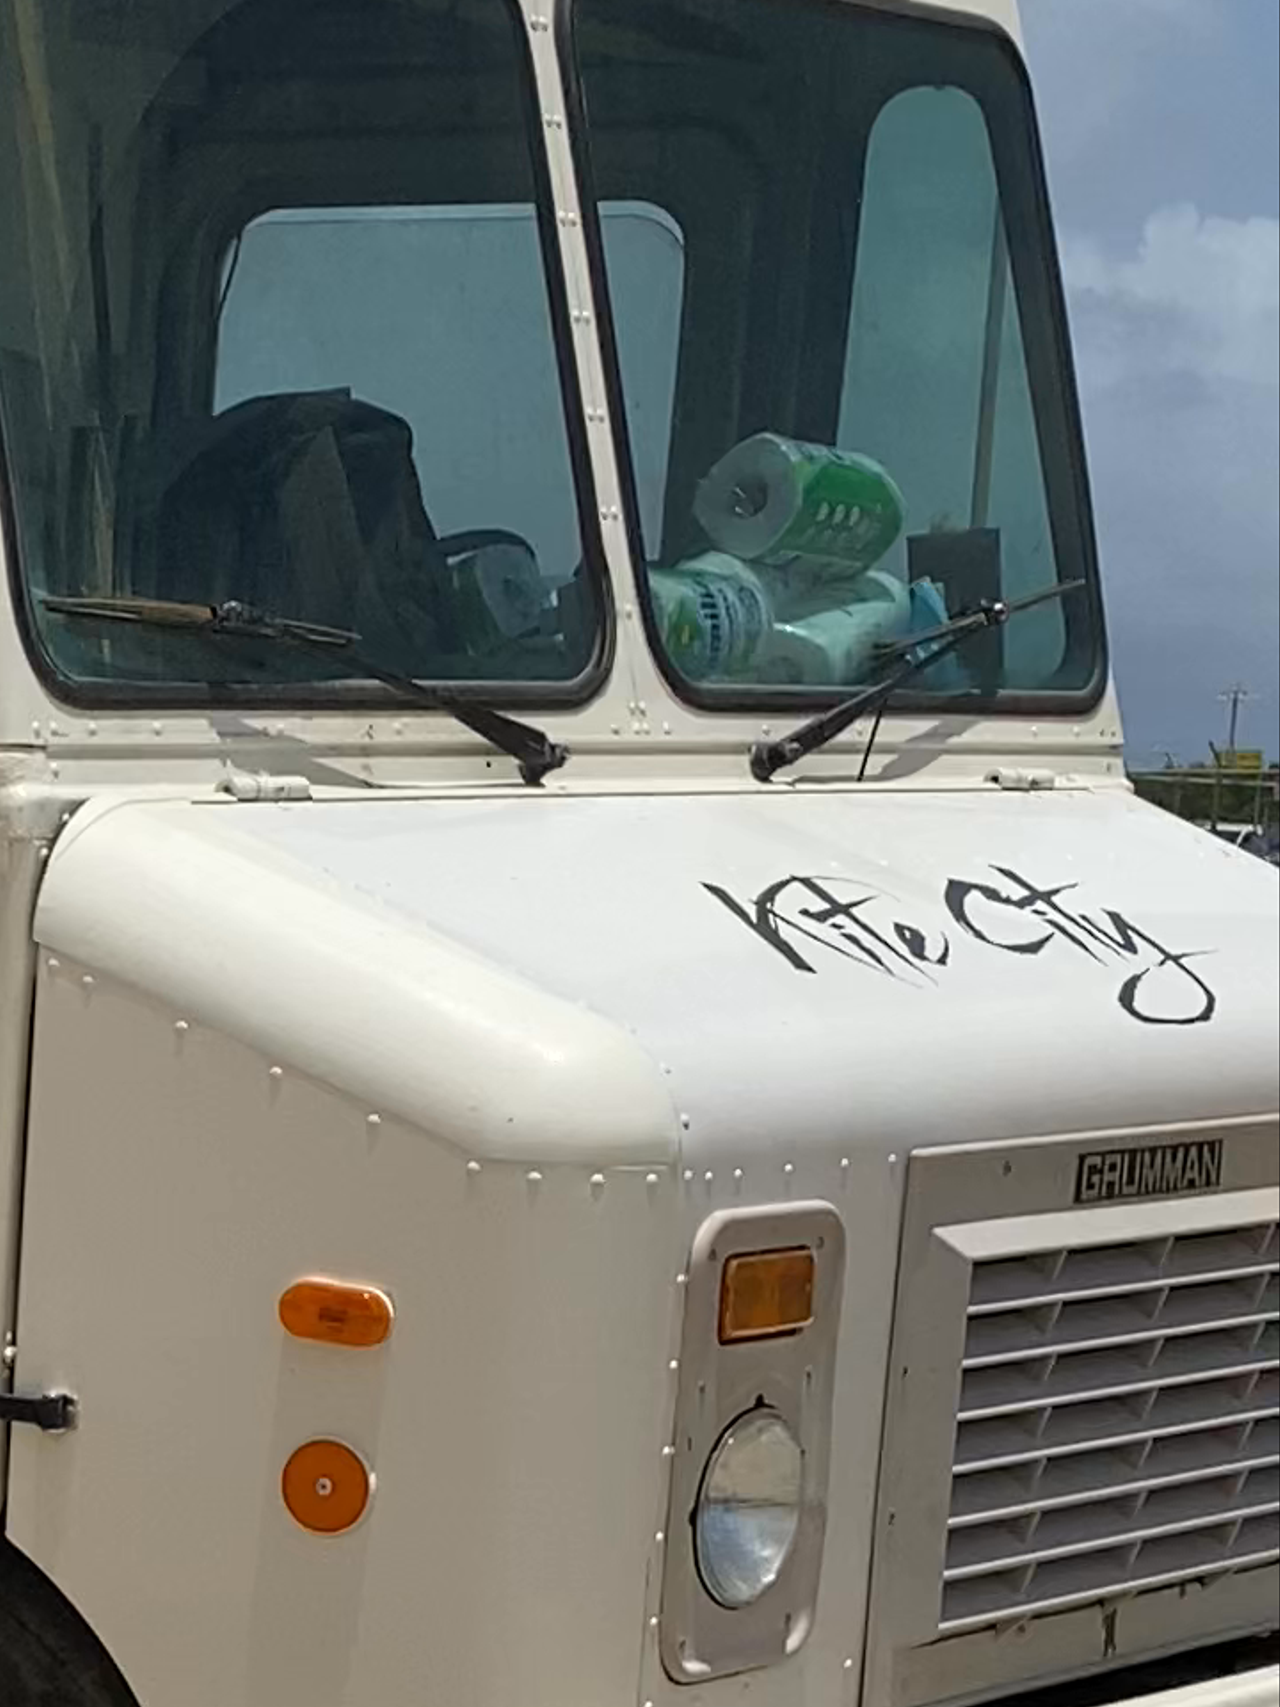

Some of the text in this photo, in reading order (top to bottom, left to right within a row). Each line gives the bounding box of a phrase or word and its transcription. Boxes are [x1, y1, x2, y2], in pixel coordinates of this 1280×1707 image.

[700, 864, 1220, 1025] Kite City
[1080, 1142, 1221, 1200] GRUMMAN
